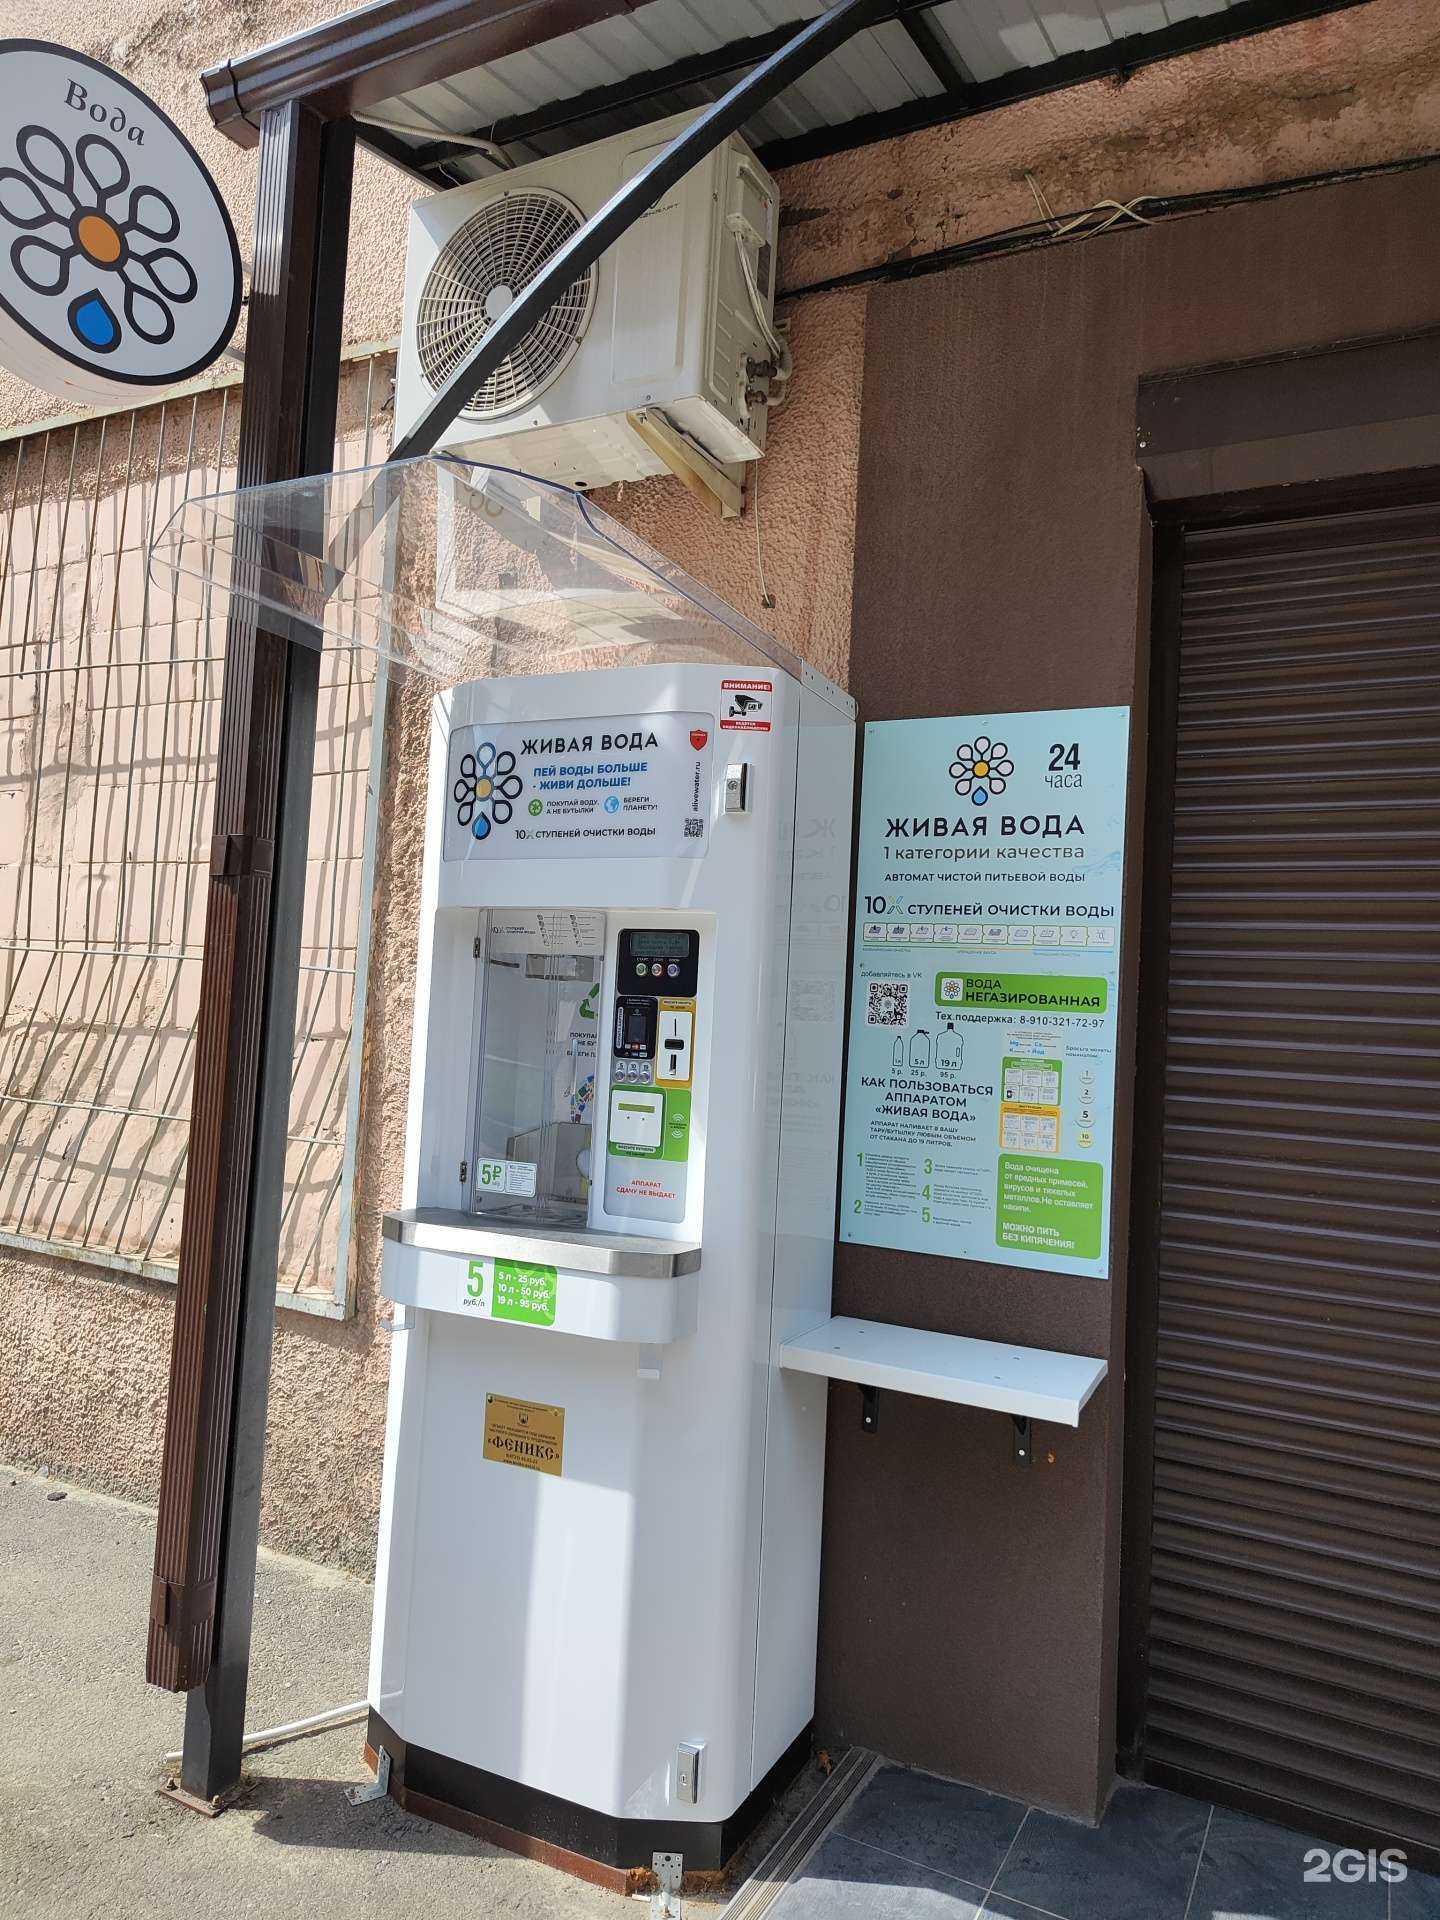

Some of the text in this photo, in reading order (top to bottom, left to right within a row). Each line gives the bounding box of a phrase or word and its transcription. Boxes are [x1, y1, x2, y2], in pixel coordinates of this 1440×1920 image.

[64, 79, 144, 145] Вода
[724, 682, 770, 691] ВНИМАНИЕ!
[521, 732, 658, 755] ЖИВАЯ ВОДА
[1048, 743, 1081, 772] 24
[534, 762, 647, 777] ПЕЙ ВОДЫ БОЛЬШЕ
[540, 780, 573, 790] ЖИВИ
[577, 777, 631, 790] ДОЛЬШЕ!
[692, 762, 701, 812] alivewater.ru
[1044, 773, 1083, 789] часа
[546, 799, 579, 807] ПОКУПАЙ
[536, 829, 581, 839] СТУПЕНЕЙ
[583, 828, 624, 837] ОЧИСТКИ
[628, 828, 656, 837] ВОДЫ
[885, 815, 1085, 838] ЖИВАЯ ВОДА
[884, 846, 1084, 862] 1 категории качества
[885, 872, 1085, 883] АВТОМАТ ЧИСТОЙ ПИТЬЕВОЙ ВОДЫ
[908, 903, 982, 916] СТУПЕНЕЙ
[988, 905, 1060, 916] ОЧИСТКИ
[1066, 906, 1114, 918] ВОДЫ
[966, 979, 1002, 990] ВОДА
[966, 992, 1100, 1007] НЕГАЗИРОВАННАЯ
[1020, 1016, 1104, 1028] 8-910-321-72-97
[862, 1077, 993, 1096] КАК ПОЛЬЗОВАТЬСЯ
[885, 1092, 967, 1108] АППАРАТОМ
[876, 1105, 976, 1122] «ЖИВАЯ ВОДА»
[857, 1153, 863, 1167] 1
[924, 1159, 933, 1174] 3
[1005, 1162, 1024, 1171] Вода
[632, 1180, 662, 1188] АППАРАТ
[616, 1187, 637, 1195] СДАЧУ
[648, 1190, 676, 1199] ВЫДАЕТ
[922, 1184, 931, 1200] 4
[854, 1200, 862, 1214] 2
[922, 1207, 931, 1223] 5
[1003, 1222, 1060, 1237] МОЖНО ПИТЬ
[1003, 1232, 1075, 1249] БЕЗ КИПЯЧЕНИЯ!
[467, 1260, 484, 1297] 5
[499, 1272, 504, 1280] 5
[518, 1275, 528, 1283] 25
[498, 1283, 507, 1292] 10
[521, 1287, 531, 1296] 50
[498, 1296, 506, 1304] 19
[520, 1299, 530, 1308] 95
